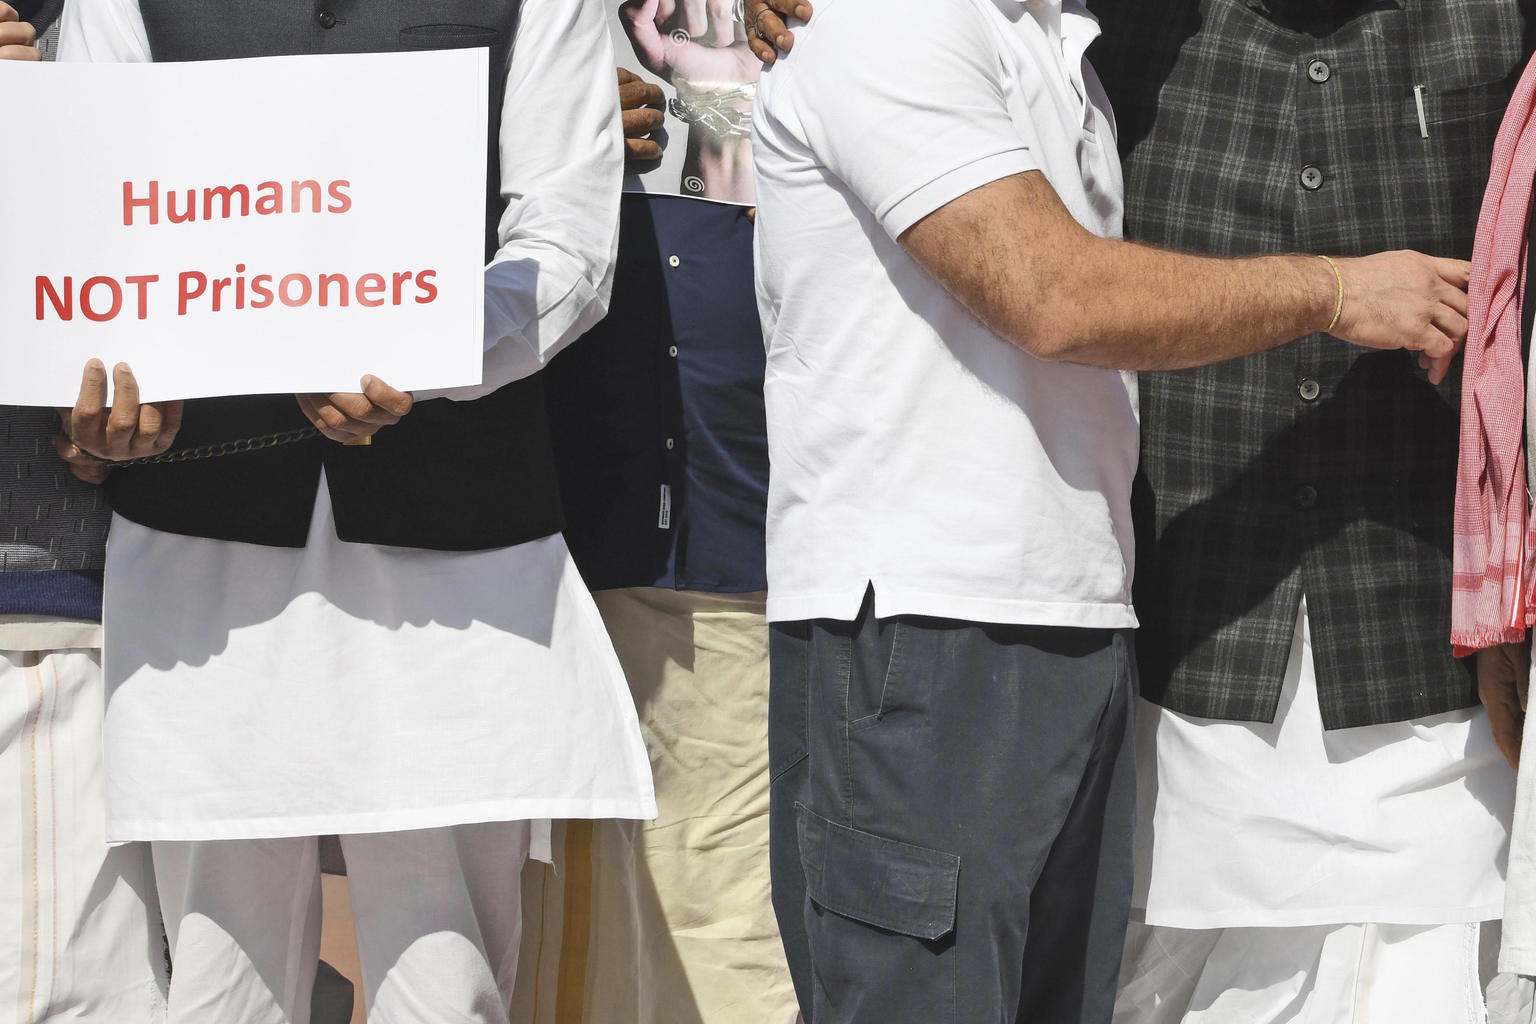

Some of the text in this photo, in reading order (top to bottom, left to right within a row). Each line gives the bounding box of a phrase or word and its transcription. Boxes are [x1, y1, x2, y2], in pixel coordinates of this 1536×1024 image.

[122, 180, 352, 227] Humans
[35, 263, 438, 323] NOT Prisoners
